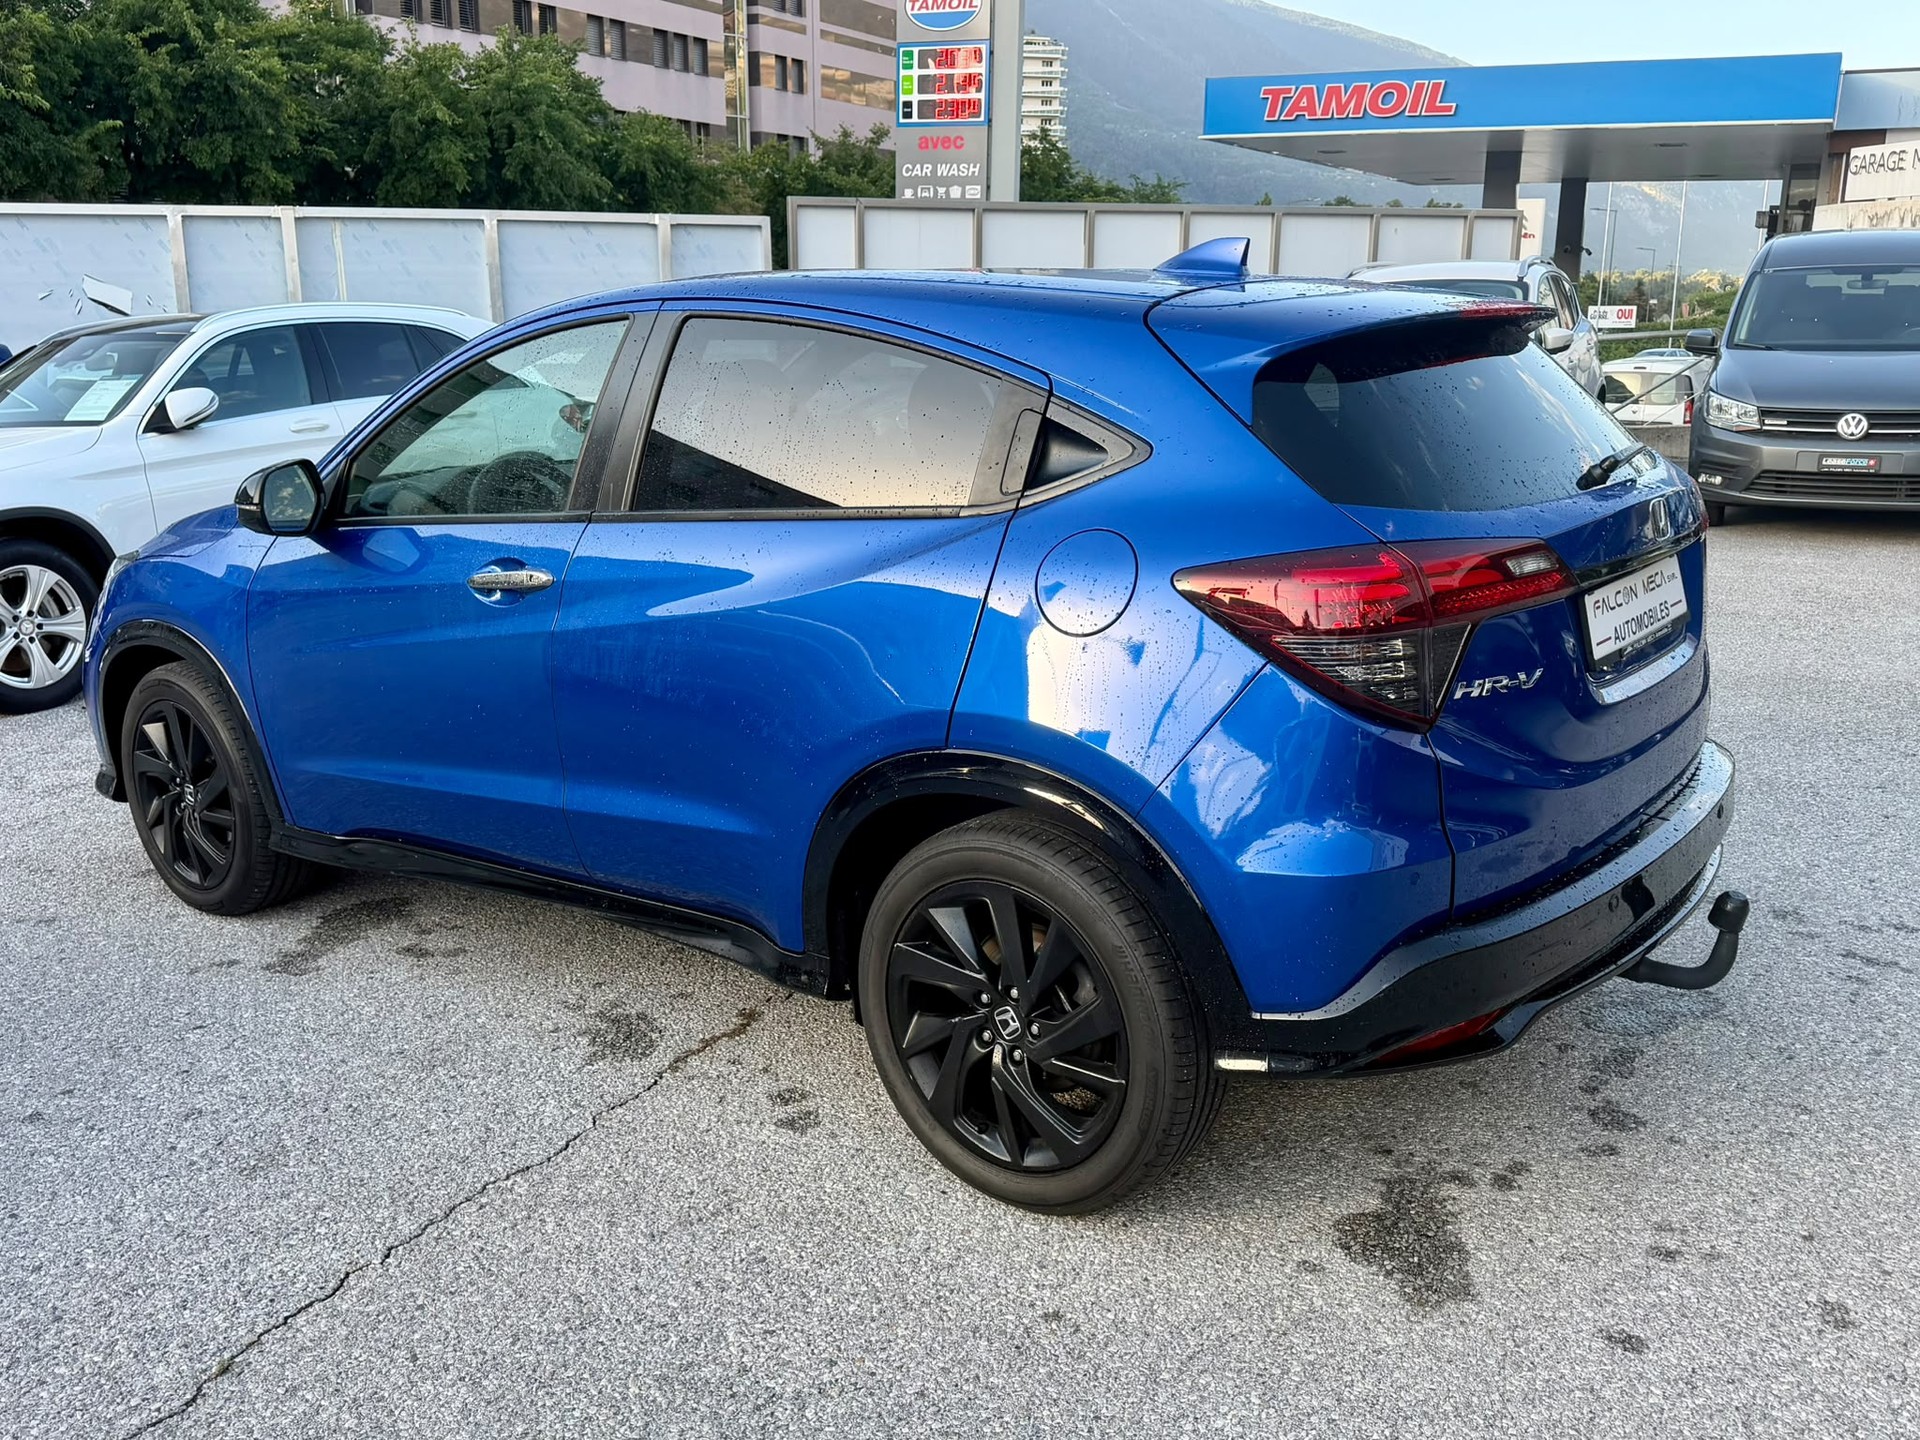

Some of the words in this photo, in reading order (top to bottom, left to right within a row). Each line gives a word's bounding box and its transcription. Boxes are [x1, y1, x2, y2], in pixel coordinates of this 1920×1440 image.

[909, 0, 979, 11] TAMOIL
[1260, 80, 1457, 121] TAMOIL
[918, 135, 965, 151] avec
[902, 163, 932, 177] CAR
[937, 162, 980, 177] WASH
[1849, 149, 1908, 176] GARAGE
[1616, 308, 1634, 320] OUI
[1593, 583, 1638, 618] FALCON
[1642, 570, 1667, 595] MECA
[1613, 600, 1670, 645] AUTOMOBILES
[1453, 667, 1544, 700] HR-V
